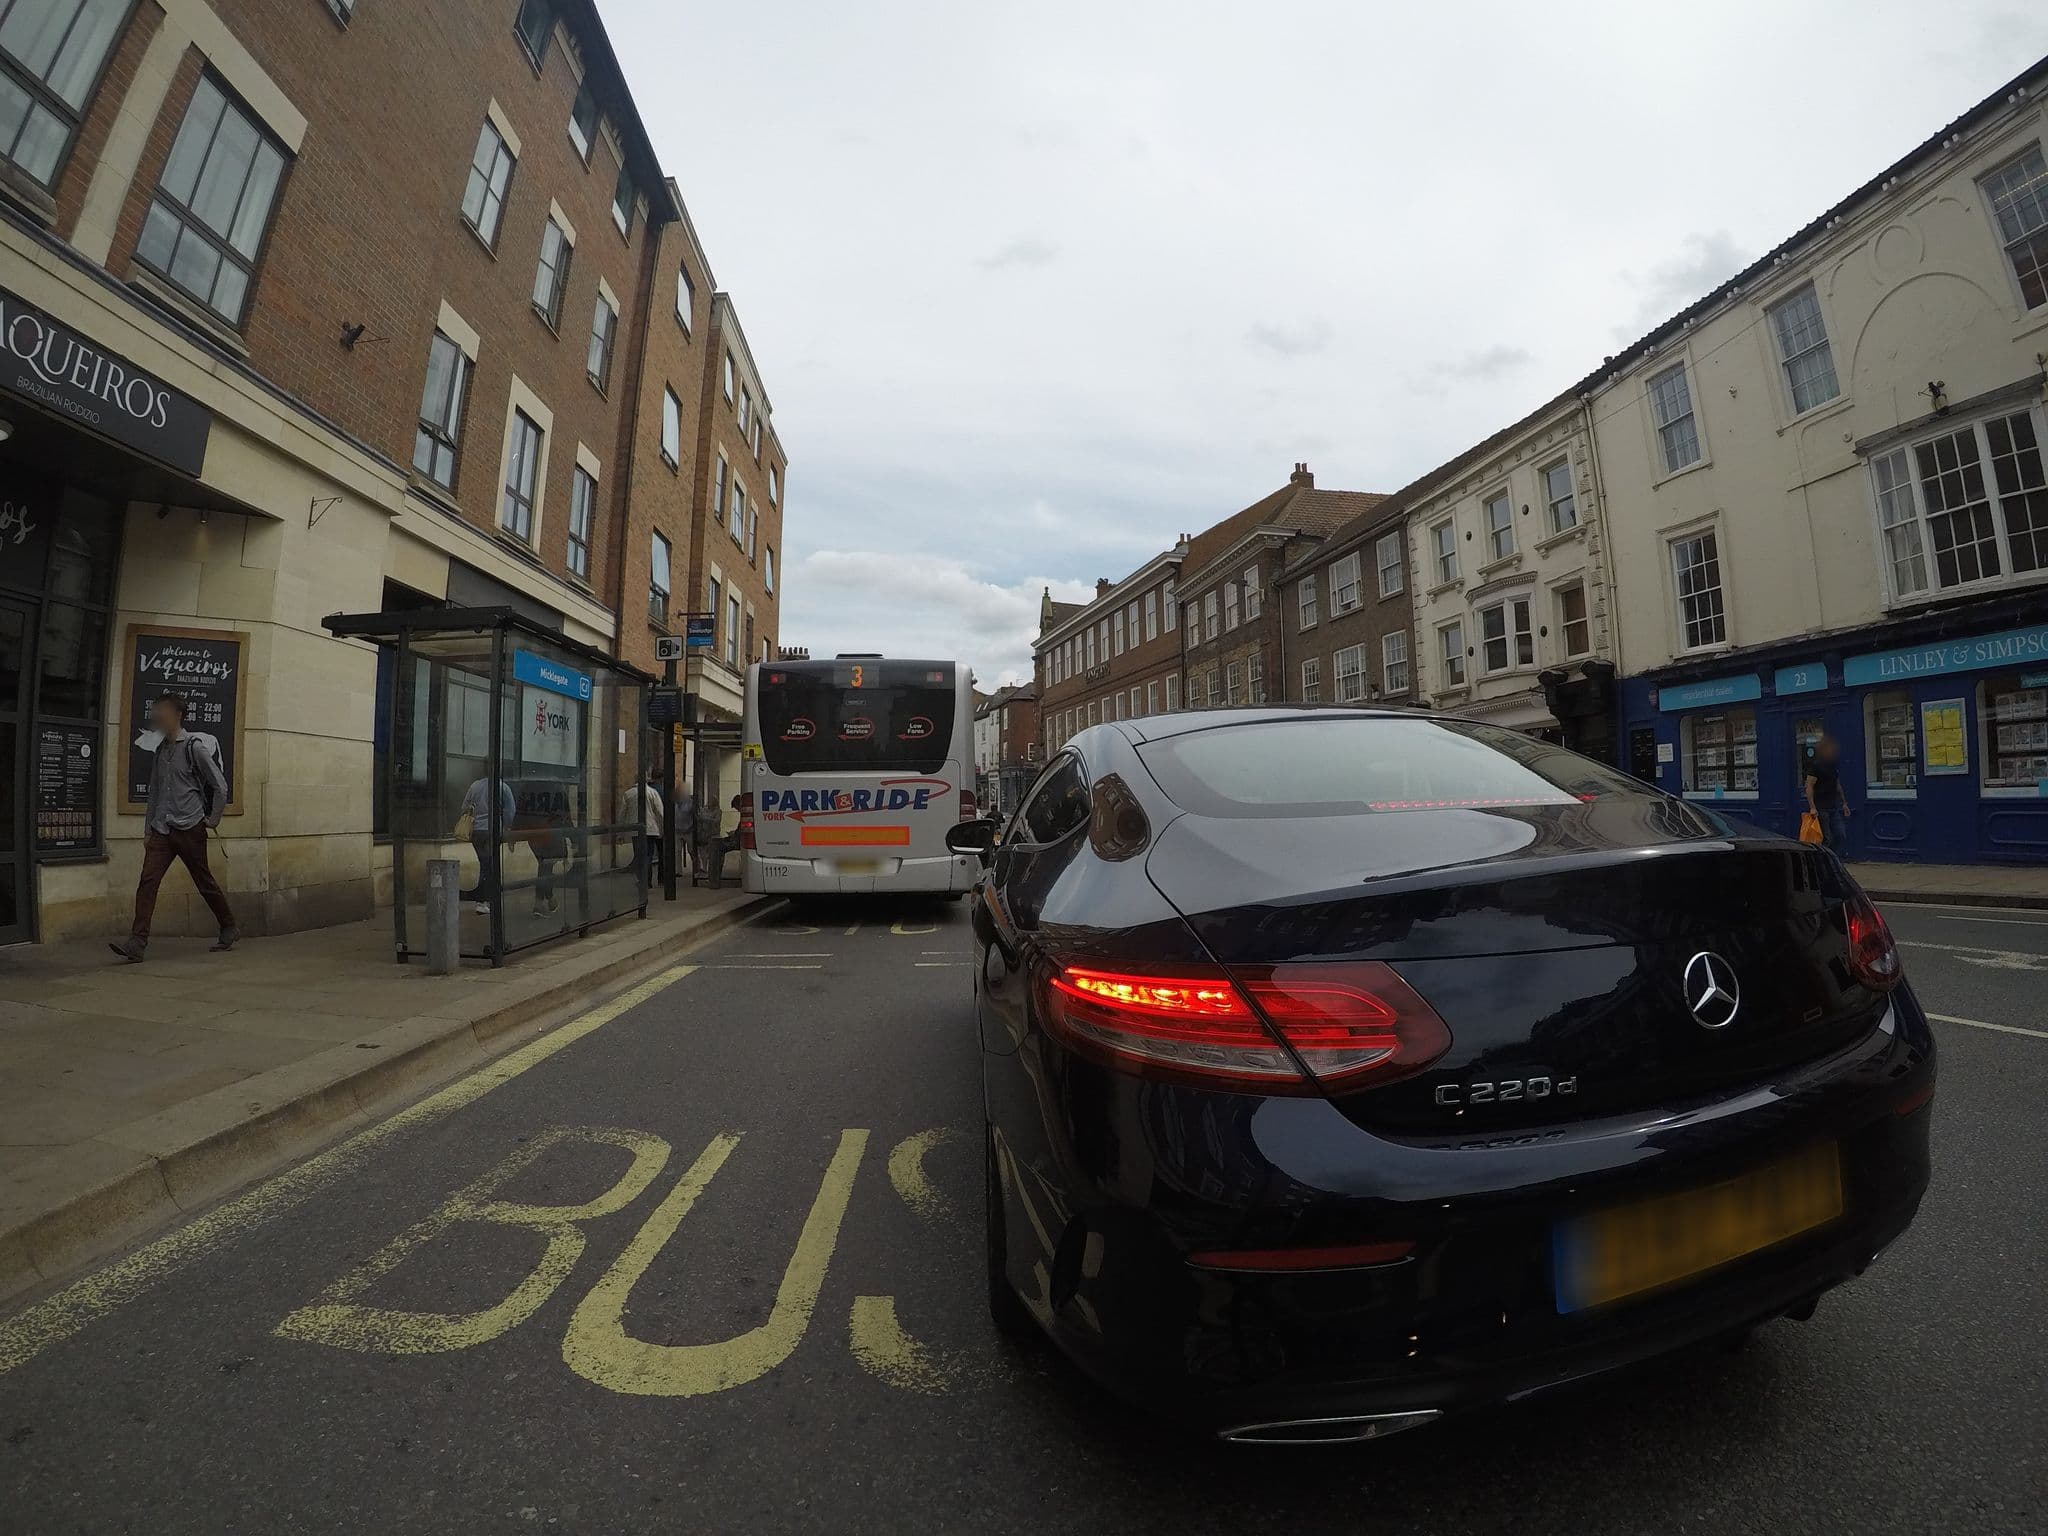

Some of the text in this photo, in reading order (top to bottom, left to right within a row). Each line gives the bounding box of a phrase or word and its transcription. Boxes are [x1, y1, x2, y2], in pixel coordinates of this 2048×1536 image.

[0, 299, 171, 428] QUEIROS
[16, 375, 101, 425] BRAZILIAN RODIZIO
[139, 651, 233, 680] Vaqueiros
[1879, 648, 1947, 676] LINLEY
[1952, 645, 1969, 665] &
[540, 667, 569, 687] Micklegate
[850, 664, 863, 688] 3
[1793, 672, 1807, 687] 23
[547, 712, 570, 732] YORK
[762, 789, 838, 812] PARK
[852, 788, 930, 811] RIDE
[762, 812, 785, 826] YORK
[765, 866, 788, 877] 11112
[1435, 1076, 1577, 1106] C 220 d
